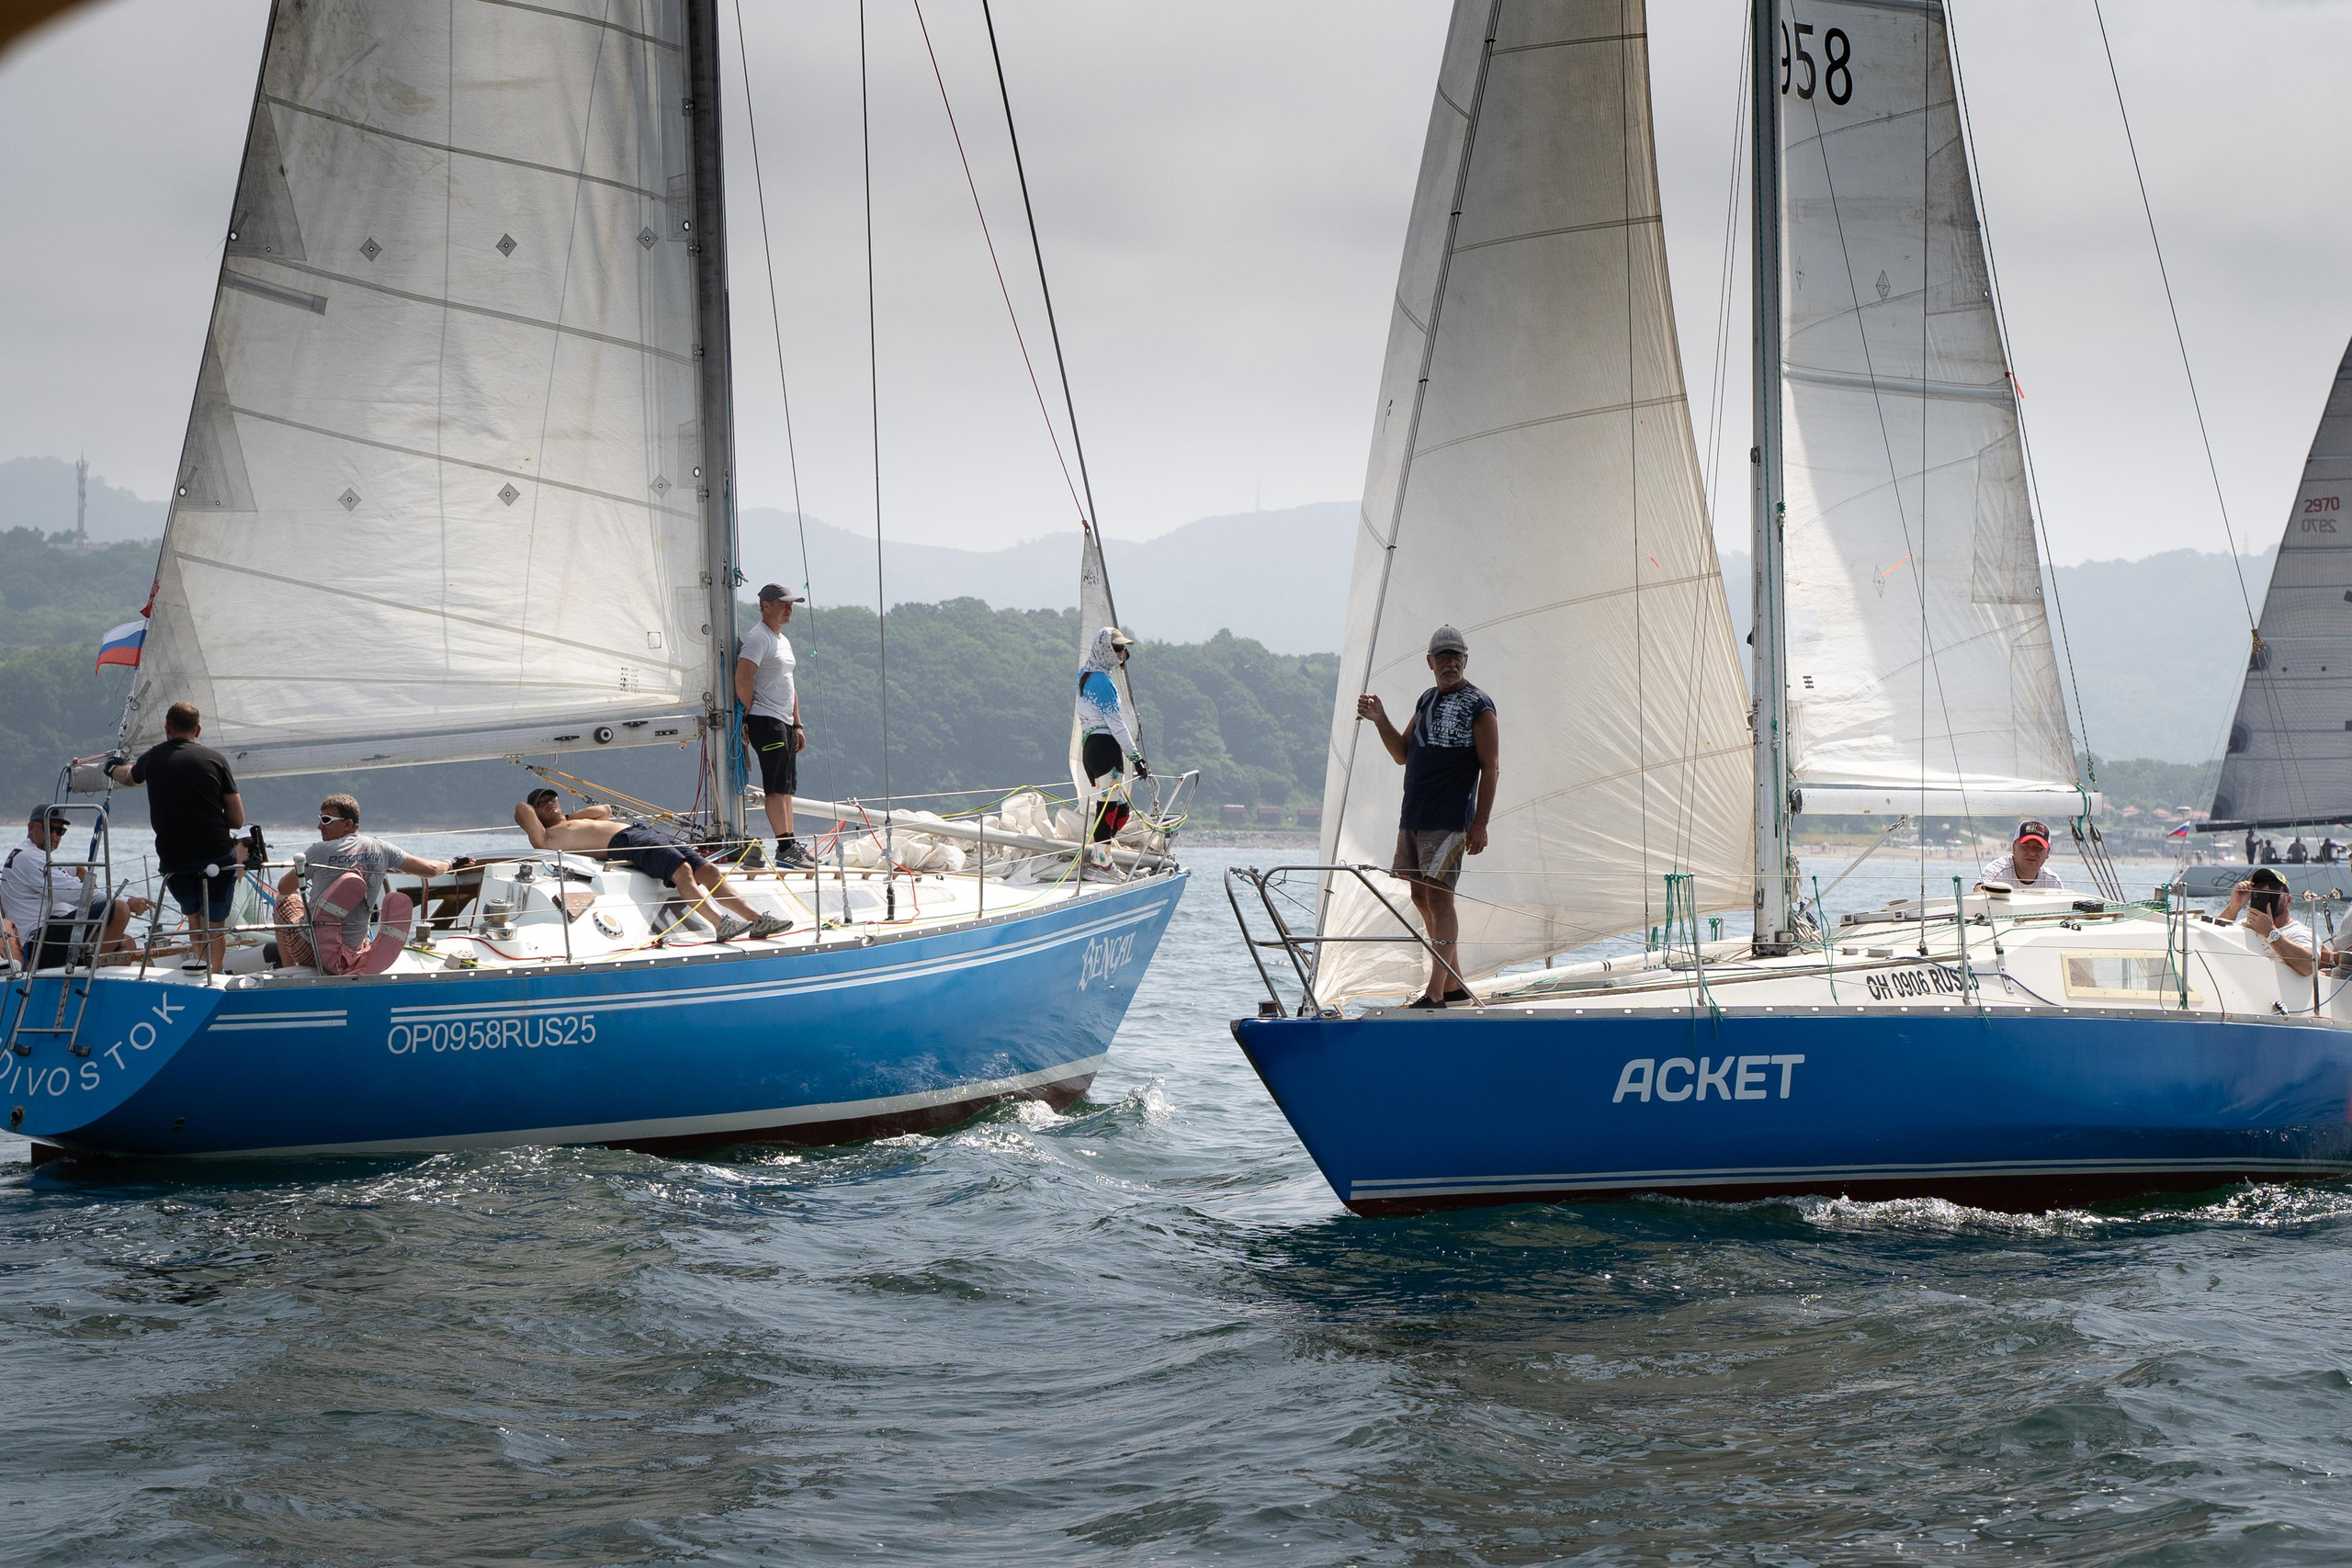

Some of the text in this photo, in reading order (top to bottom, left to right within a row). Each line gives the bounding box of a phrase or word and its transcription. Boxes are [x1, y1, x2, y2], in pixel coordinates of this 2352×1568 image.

[2304, 496, 2340, 513] 2970
[1077, 931, 1136, 992] BENGAL
[1892, 970, 1930, 998] 0906
[1928, 967, 1980, 994] RUS5
[0, 991, 186, 1097] DIVOSTOK
[387, 1014, 596, 1055] OP0958RUS25
[1612, 1054, 1805, 1103] ACKET
